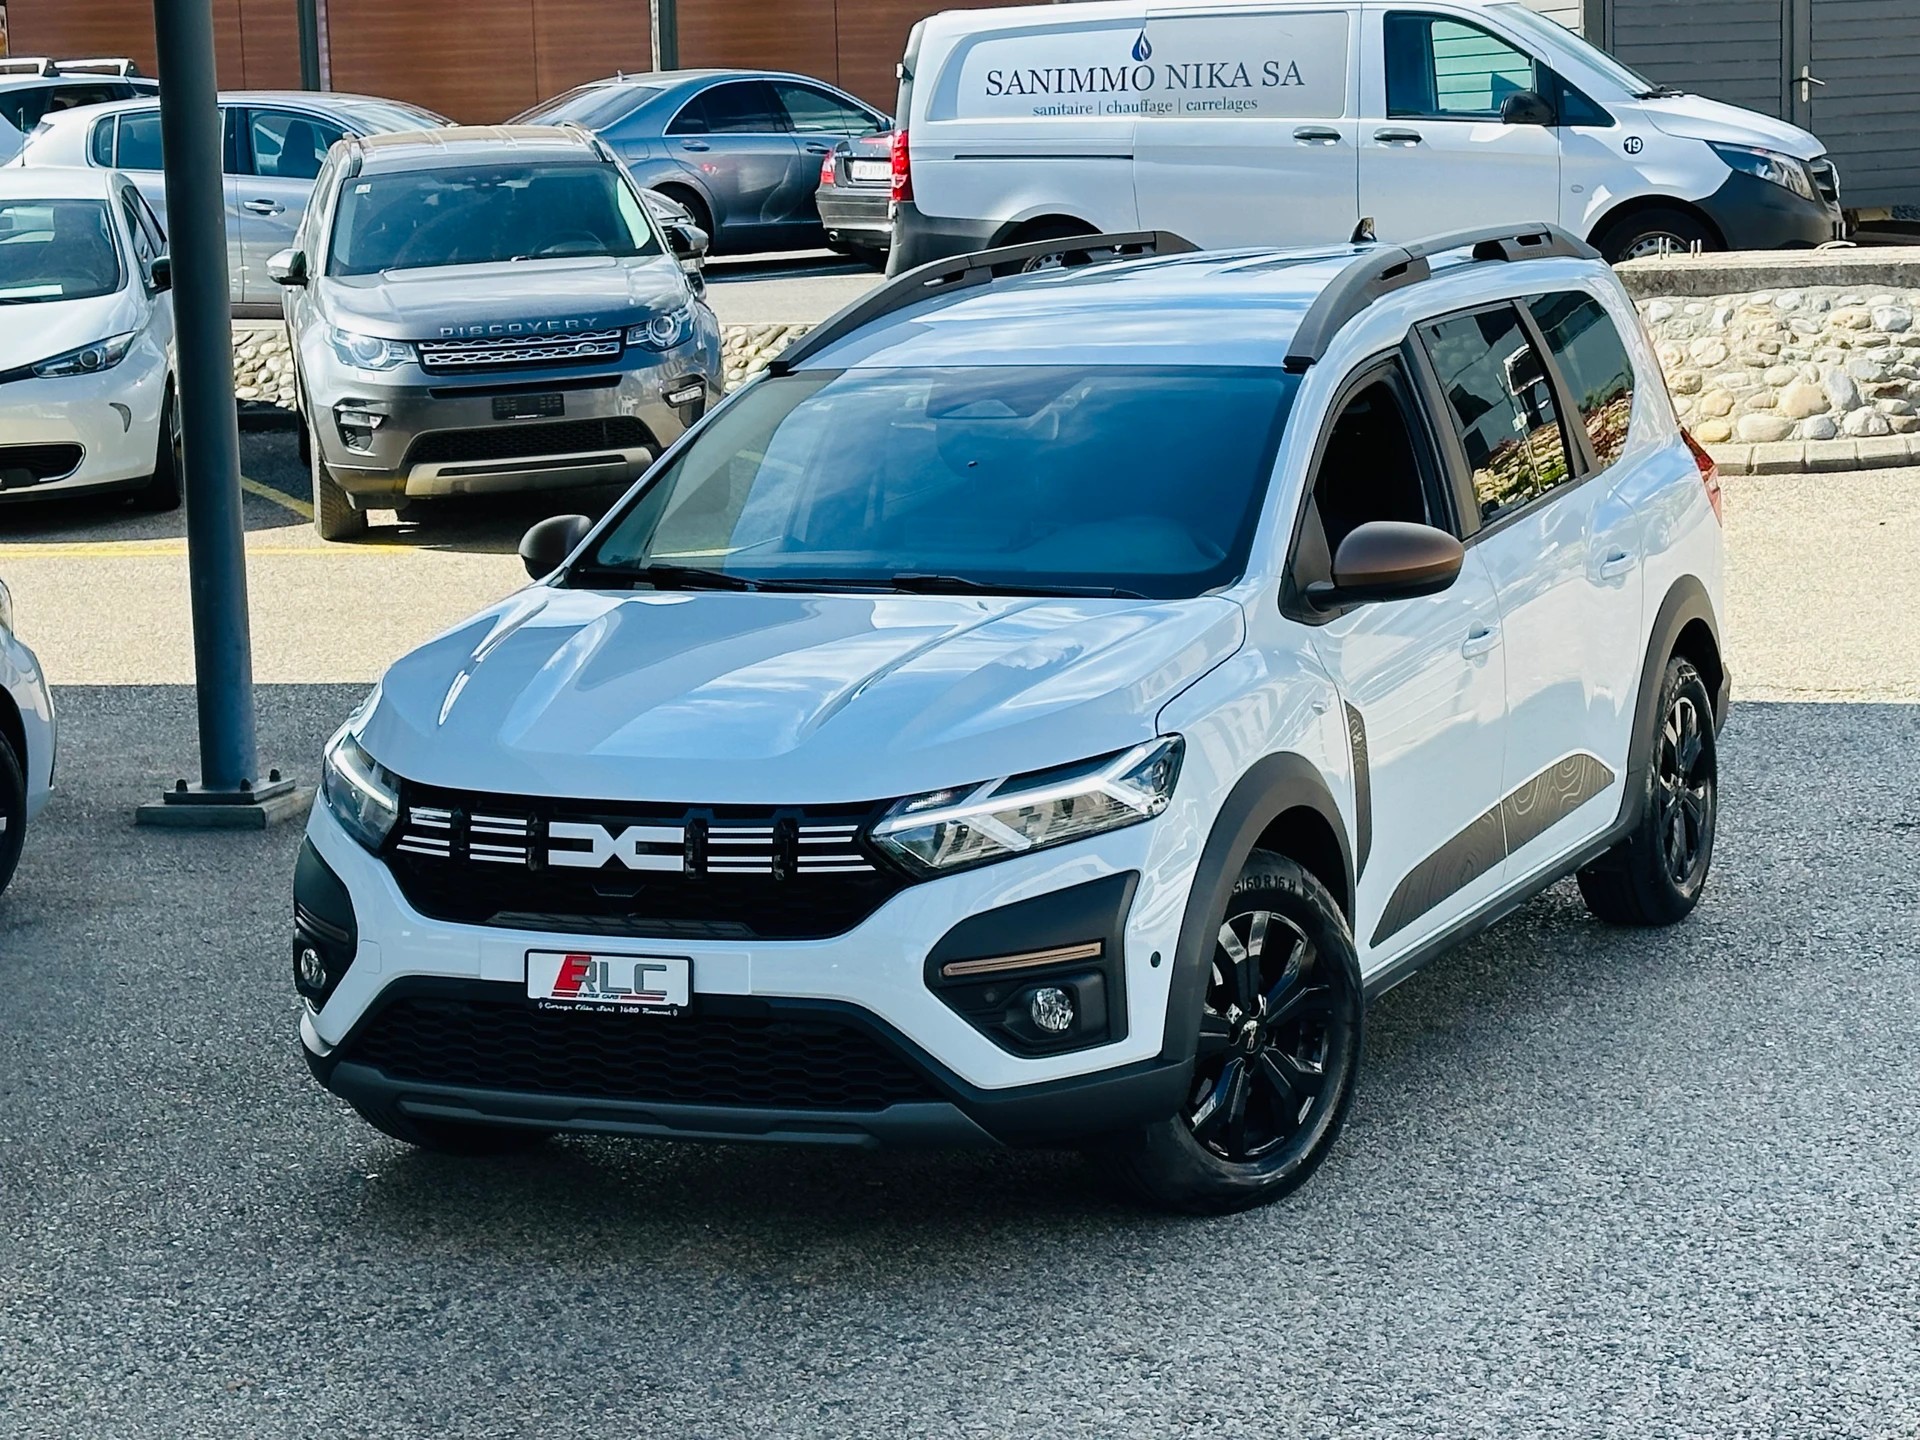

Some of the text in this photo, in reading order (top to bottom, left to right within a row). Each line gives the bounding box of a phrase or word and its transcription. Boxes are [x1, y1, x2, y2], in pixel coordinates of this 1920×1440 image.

[986, 60, 1306, 96] SANIMMO NIKA SA
[1033, 97, 1258, 116] sanitaire chauffage carrelages
[1625, 138, 1641, 152] 19
[440, 318, 598, 337] DISCOVERY
